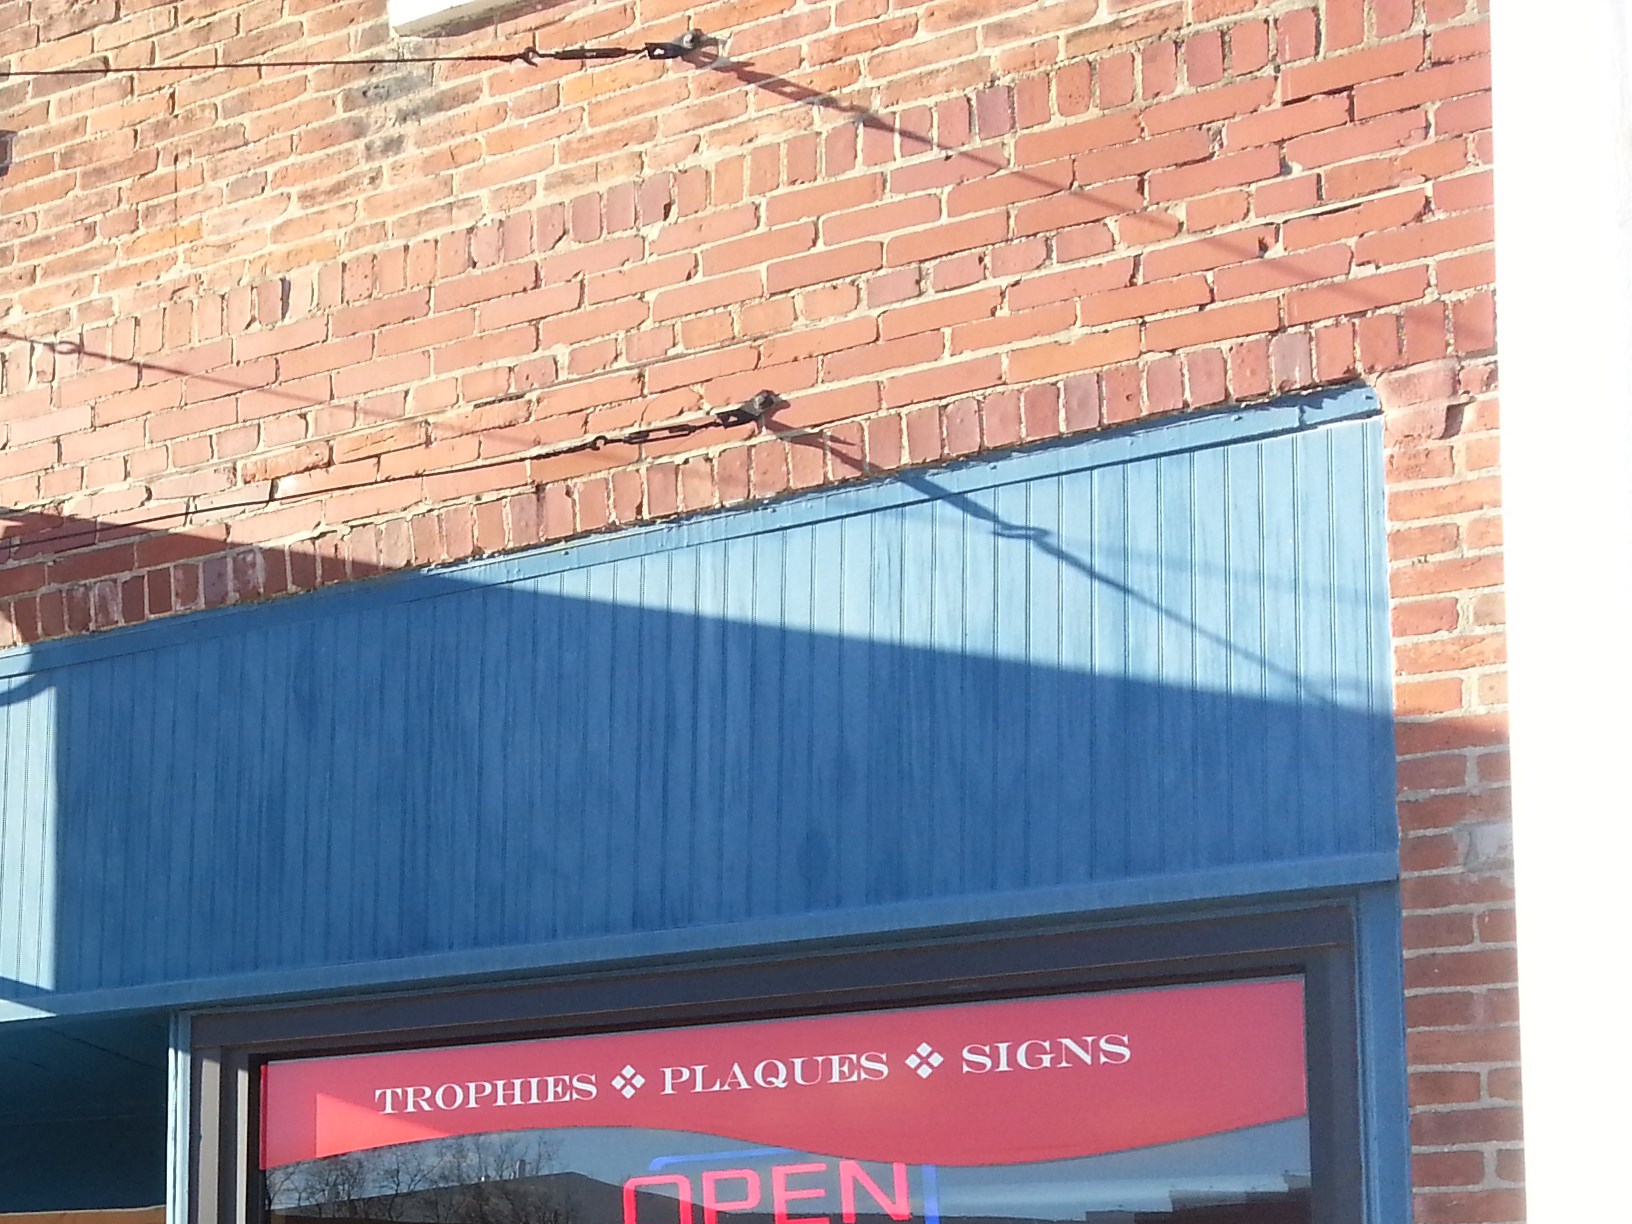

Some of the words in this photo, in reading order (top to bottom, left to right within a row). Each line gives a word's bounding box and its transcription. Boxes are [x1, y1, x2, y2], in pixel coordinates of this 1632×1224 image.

[375, 1072, 598, 1115] TROPHIES
[660, 1051, 889, 1095] PLAQUES
[961, 1033, 1132, 1074] SIGNS
